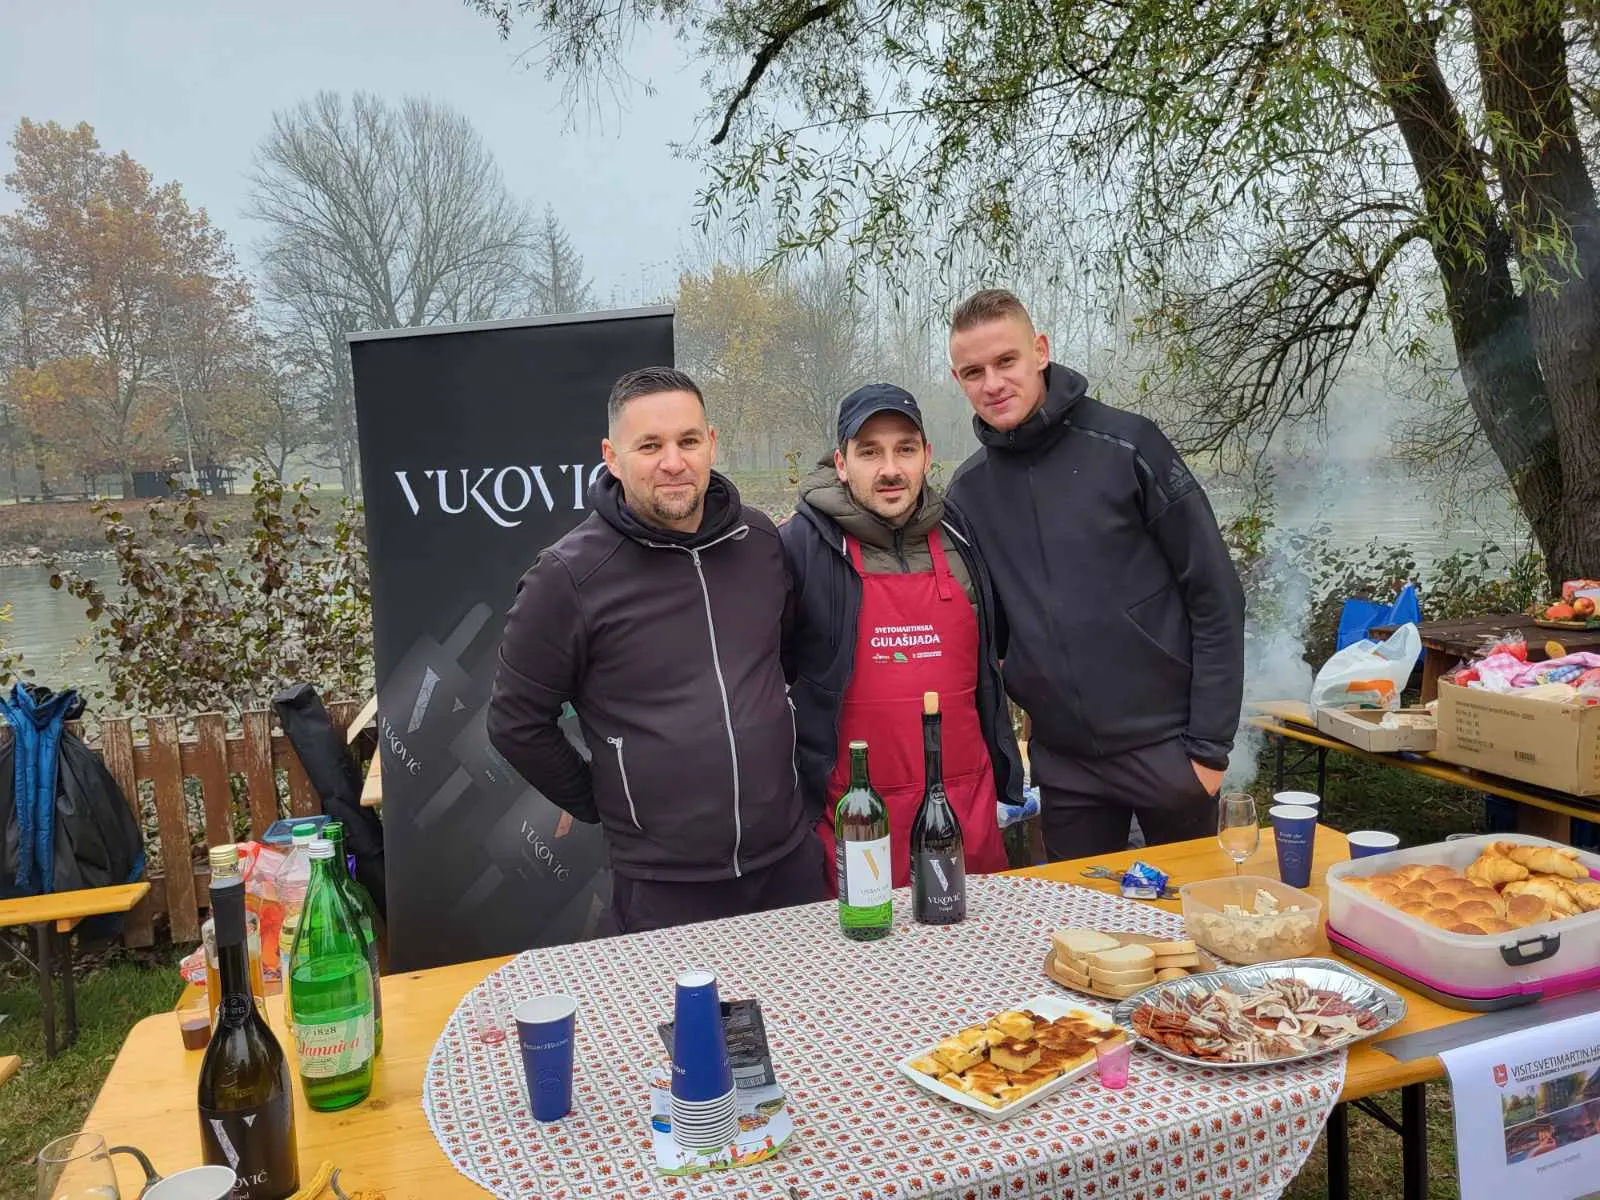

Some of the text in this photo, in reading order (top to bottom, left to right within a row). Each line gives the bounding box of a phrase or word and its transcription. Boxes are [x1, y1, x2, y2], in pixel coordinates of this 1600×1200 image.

[870, 633, 941, 648] GULAŠIJADA
[313, 1026, 337, 1036] 1828
[232, 1168, 269, 1191] OVIĆ
